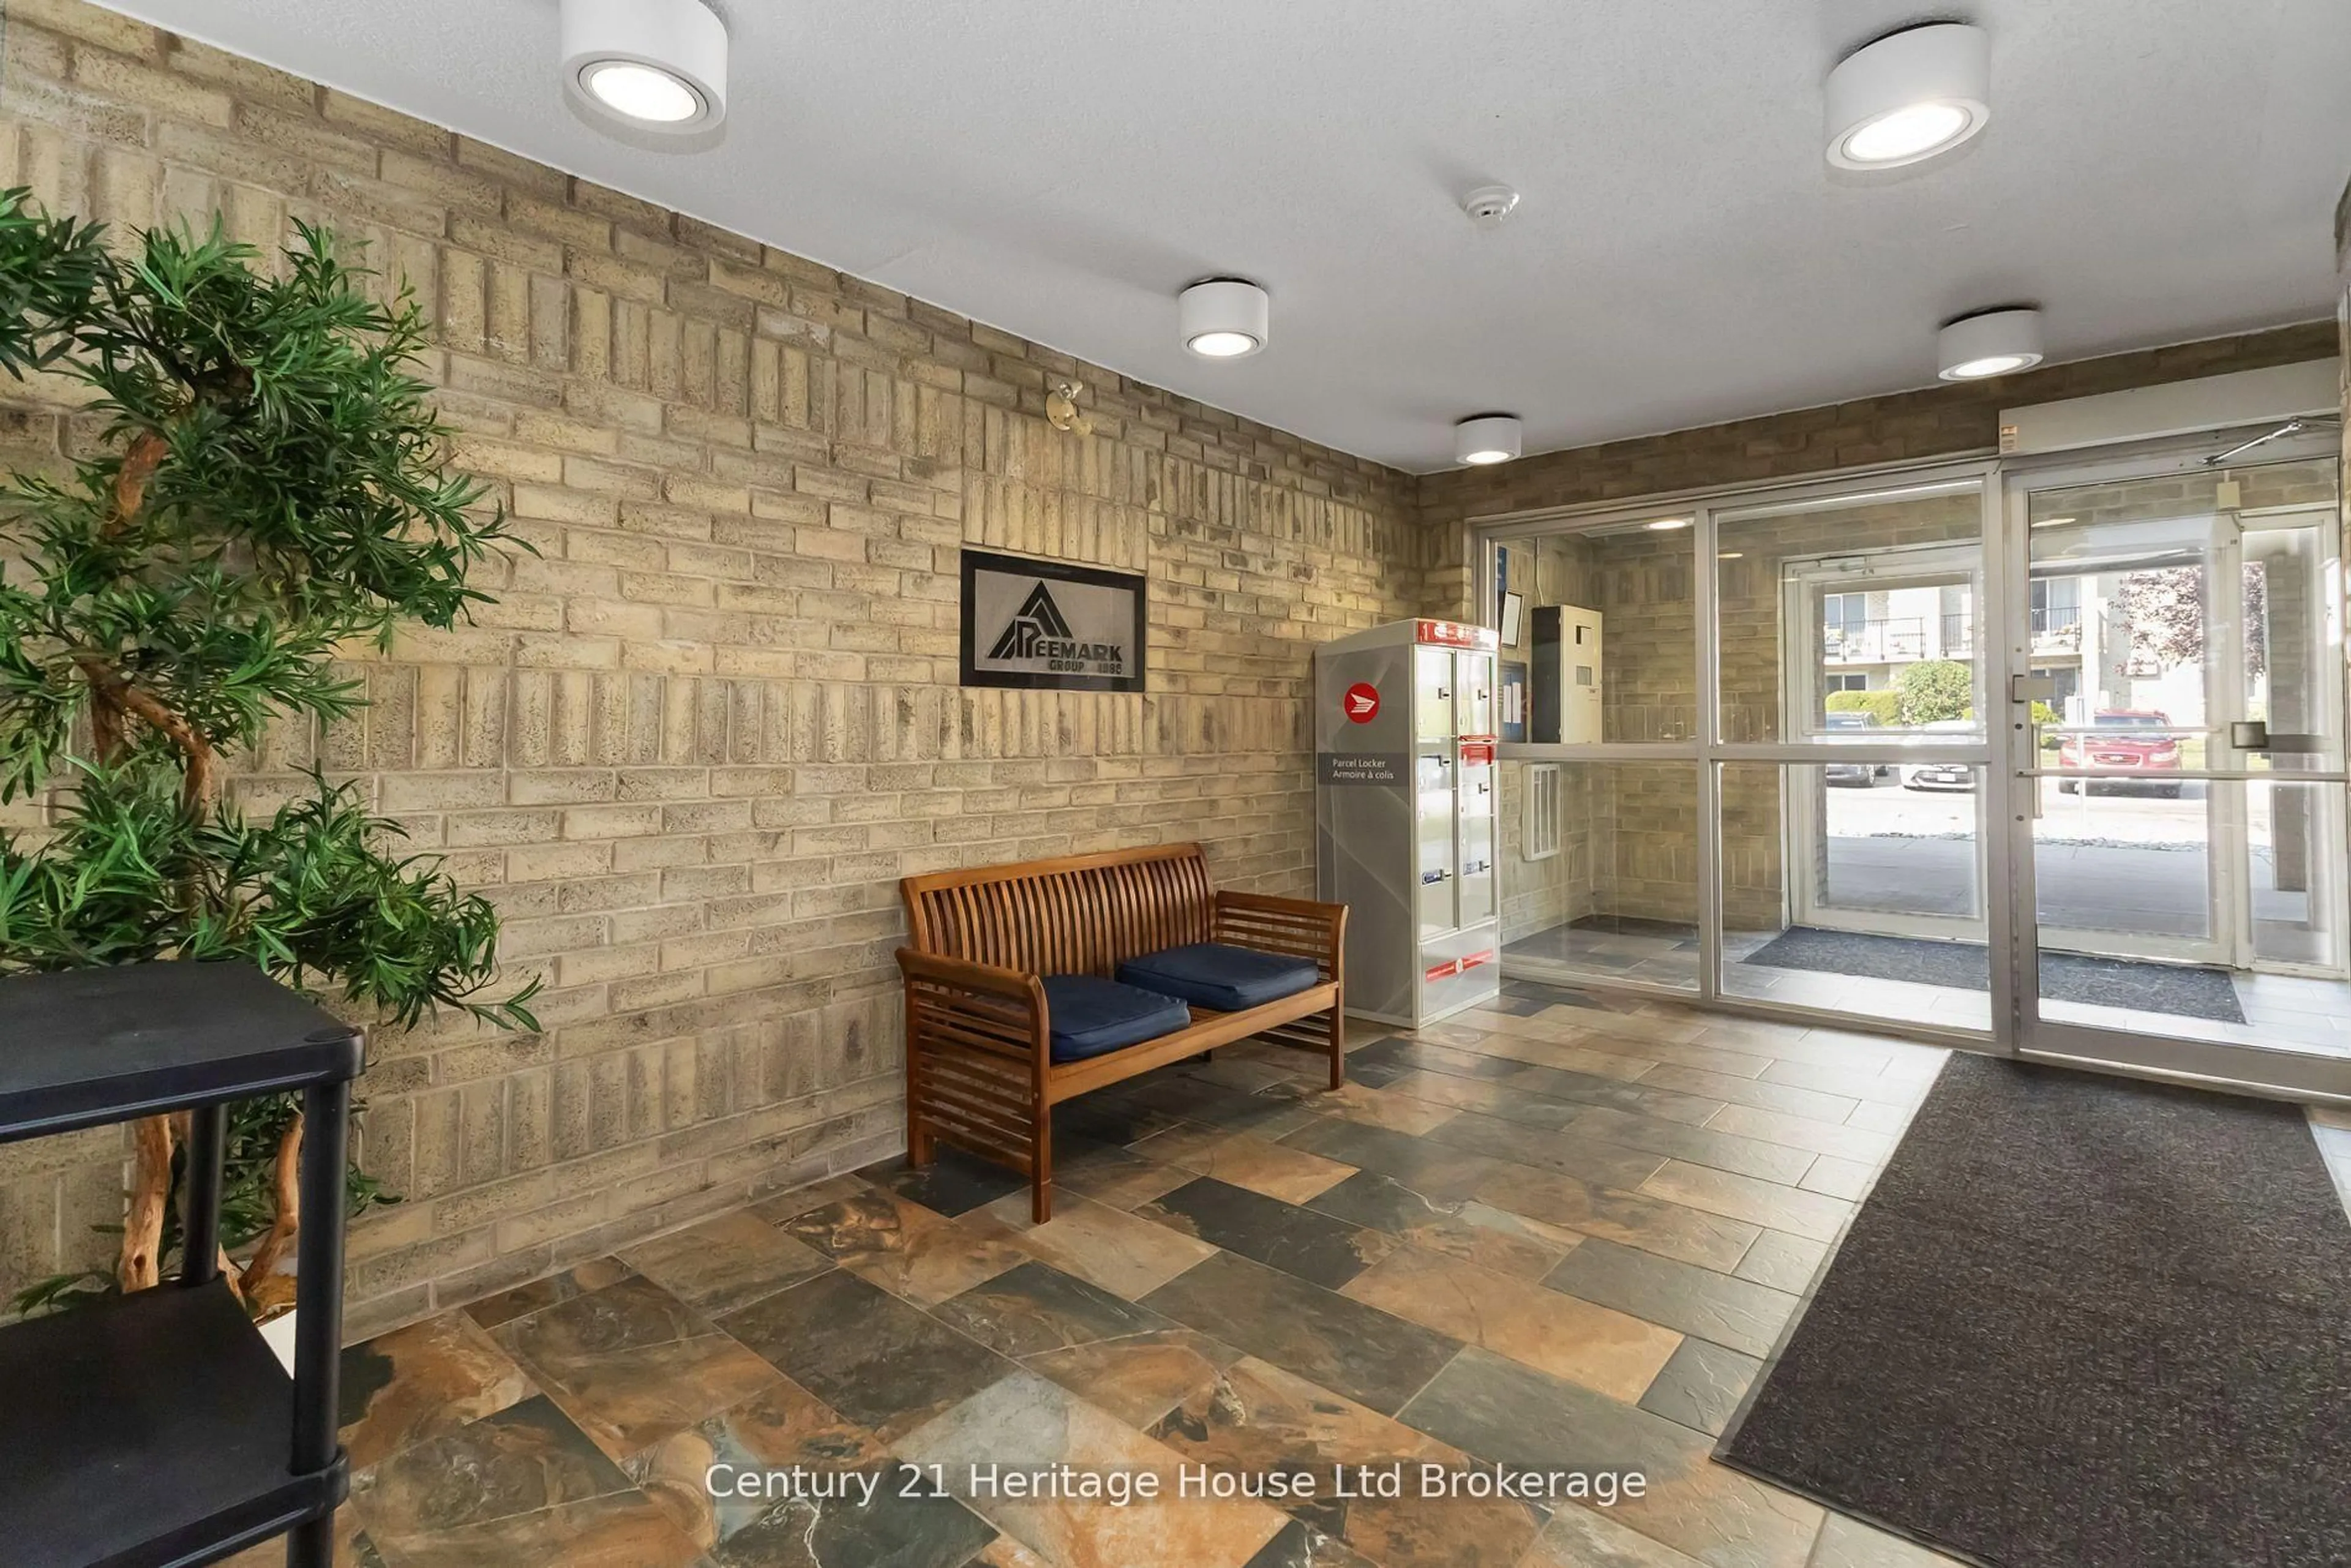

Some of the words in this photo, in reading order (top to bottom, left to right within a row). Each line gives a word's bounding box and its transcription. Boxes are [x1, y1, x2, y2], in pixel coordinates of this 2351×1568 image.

[1049, 659, 1085, 672] GROUP
[1332, 759, 1357, 768] Parcel
[1358, 759, 1386, 768] Locker
[1332, 770, 1366, 779] Armoire
[1374, 770, 1395, 779] colis
